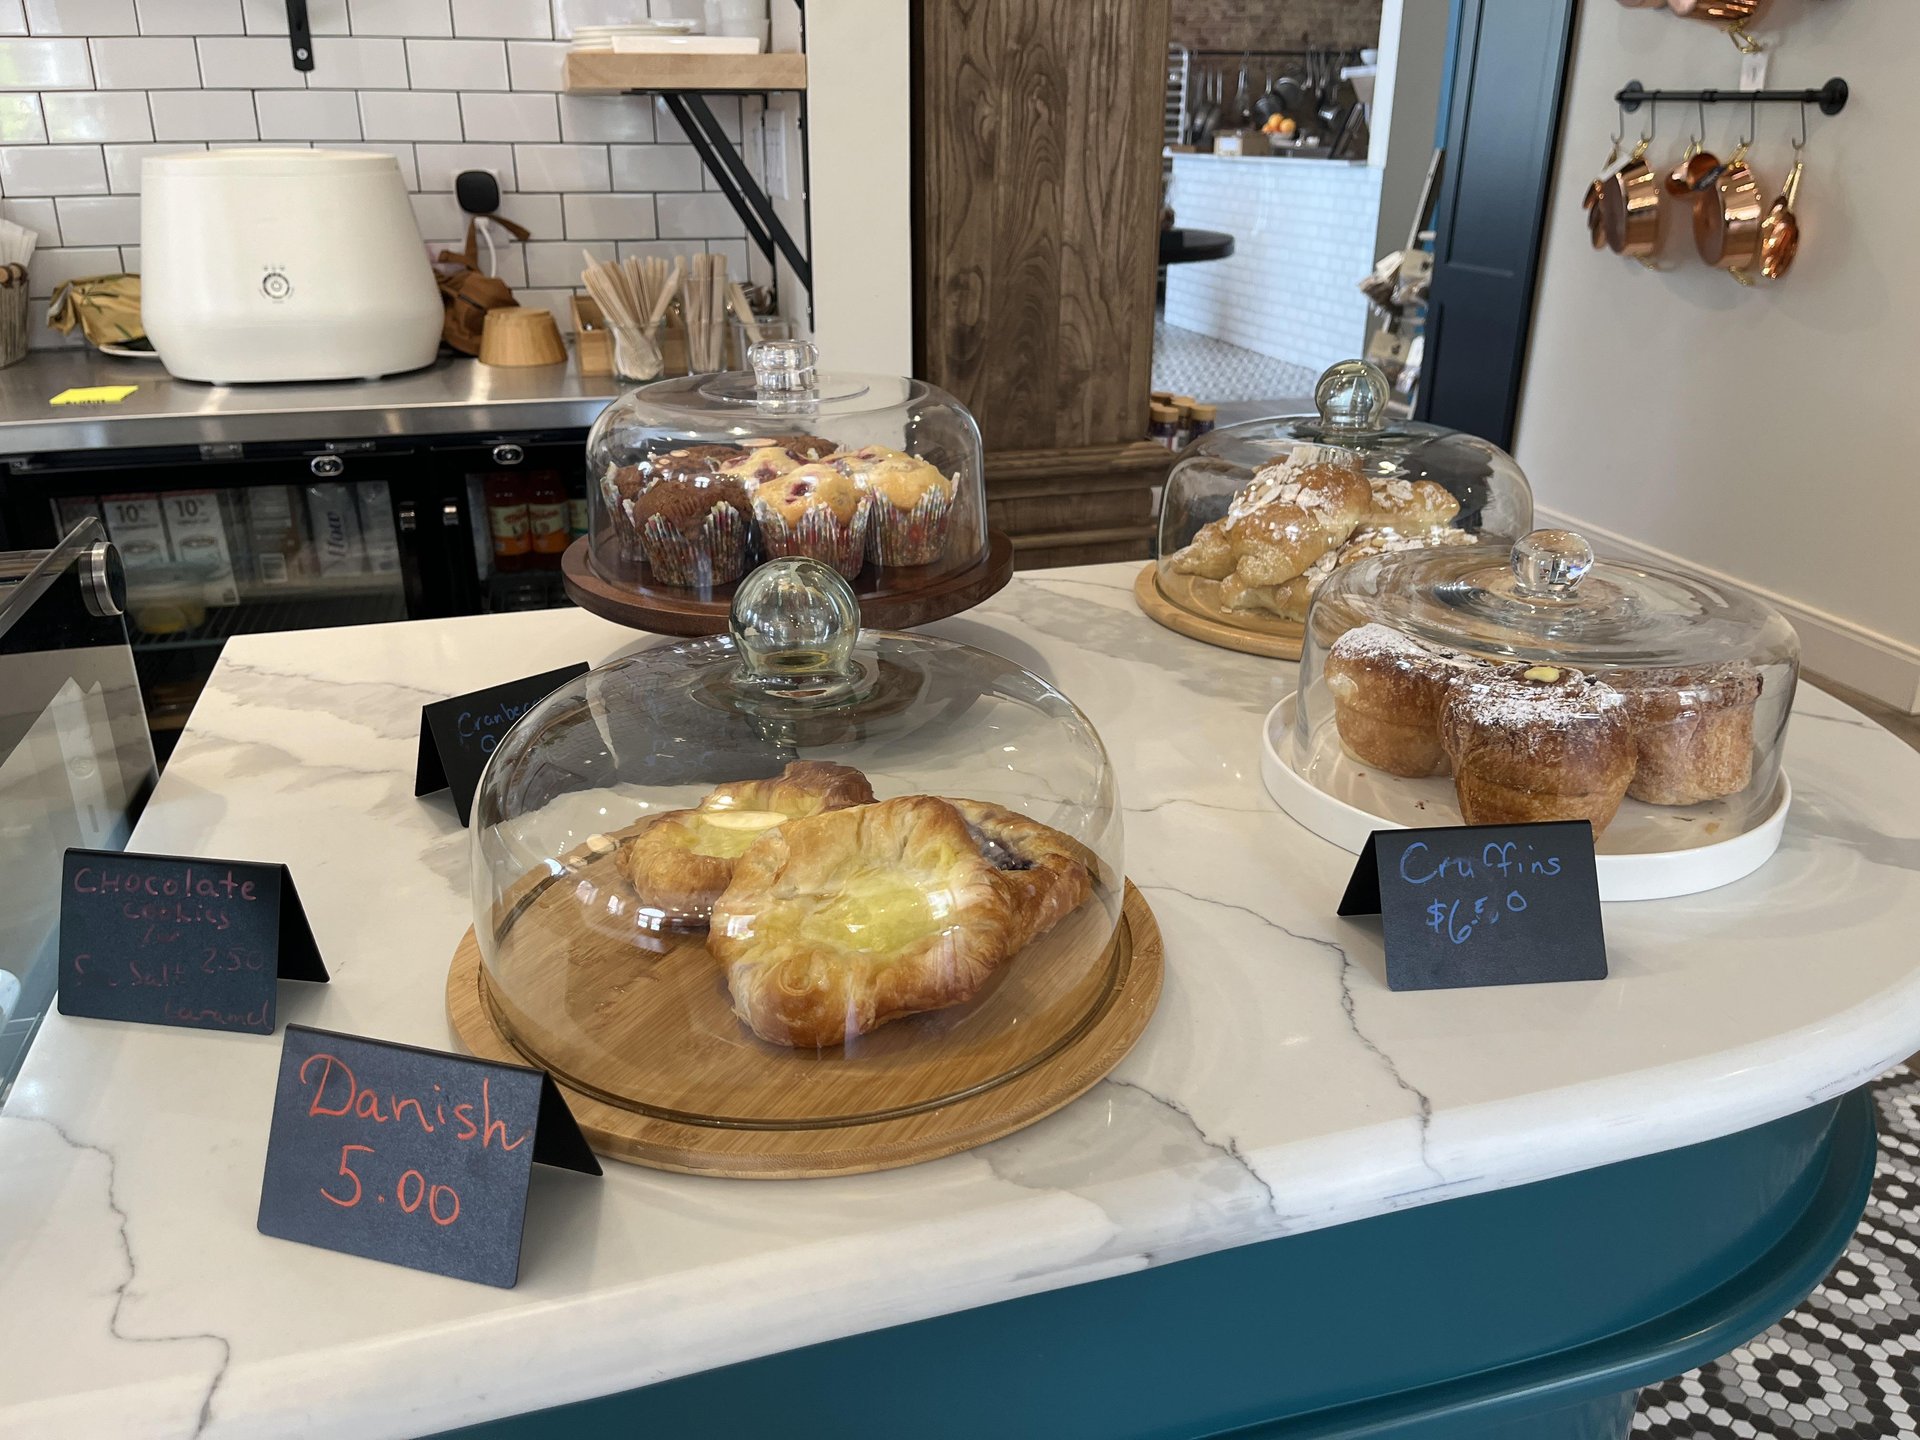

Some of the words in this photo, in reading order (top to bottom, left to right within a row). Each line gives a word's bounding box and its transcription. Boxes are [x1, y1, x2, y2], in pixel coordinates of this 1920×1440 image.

[1400, 842, 1562, 884] Cruffins
[299, 1052, 532, 1152] Danish
[319, 1143, 462, 1227] 5.00
